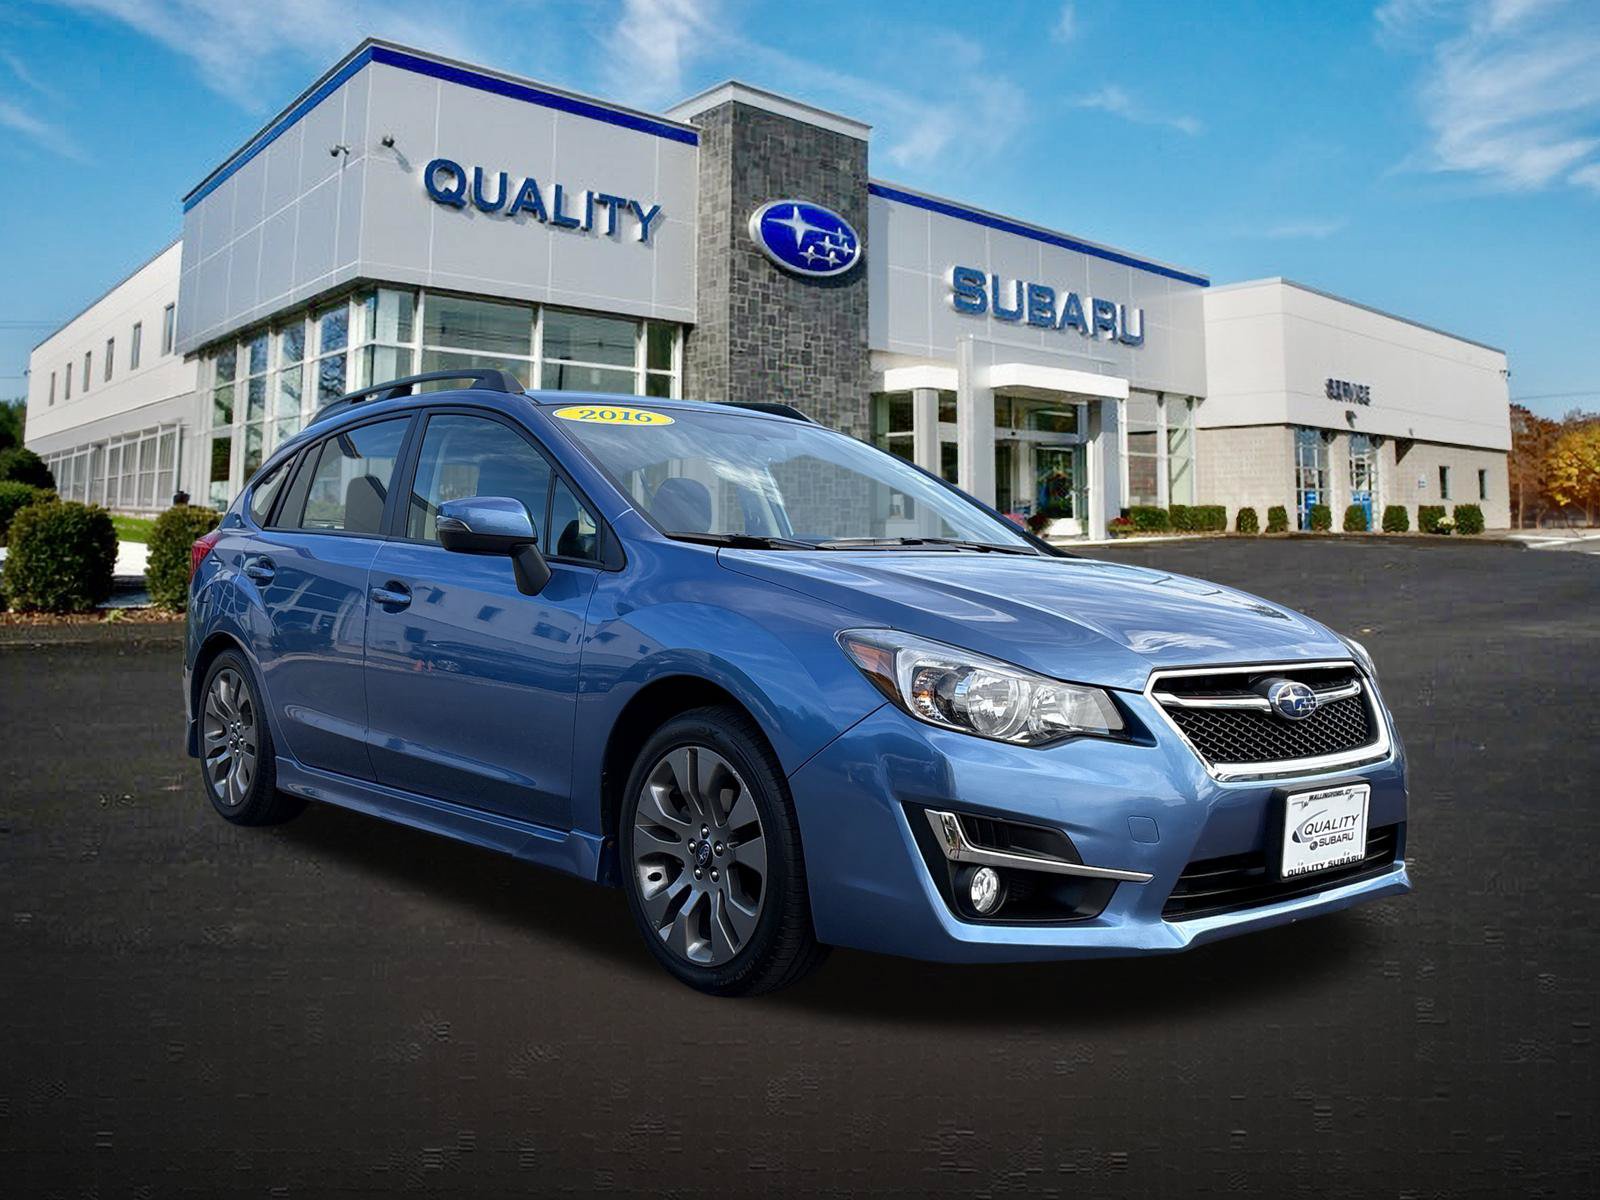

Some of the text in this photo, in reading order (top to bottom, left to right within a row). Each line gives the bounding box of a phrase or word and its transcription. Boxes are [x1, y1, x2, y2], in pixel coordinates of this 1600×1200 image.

[424, 158, 661, 243] QUALITY
[949, 265, 1145, 347] SUBARU
[1325, 378, 1371, 406] SERVICE
[579, 409, 652, 423] 2016
[1304, 814, 1360, 836] QUALITY
[1318, 832, 1354, 847] SUBARU
[1287, 854, 1363, 877] QUALITY SUBARU
